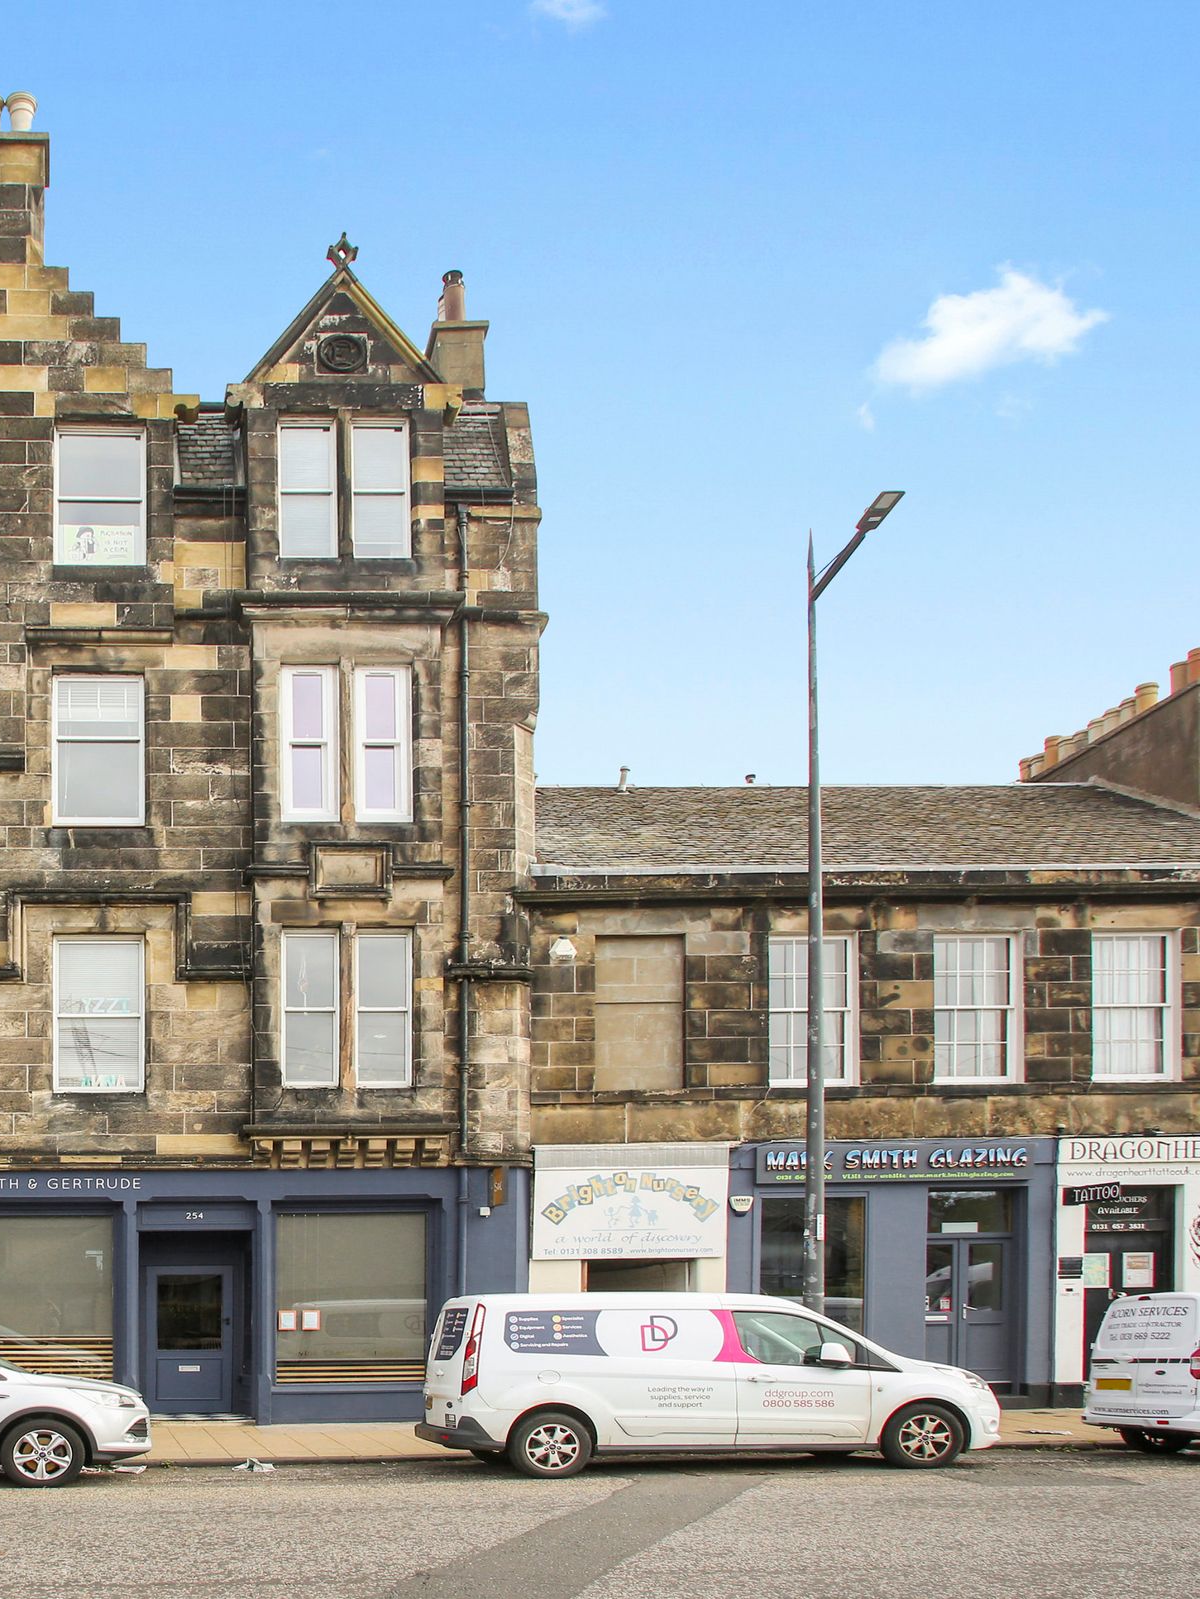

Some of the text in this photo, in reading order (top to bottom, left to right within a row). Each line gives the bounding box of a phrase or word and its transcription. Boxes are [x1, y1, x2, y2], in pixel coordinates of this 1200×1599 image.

[845, 1149, 918, 1169] SMITH
[929, 1147, 1028, 1168] GLAZING
[27, 1178, 38, 1190] &
[47, 1178, 142, 1190] GERTRUDE
[542, 1171, 720, 1225] Brighton Nursery
[1073, 1184, 1120, 1202] TATTOO
[186, 1212, 204, 1220] 254
[574, 1232, 612, 1243] world
[621, 1232, 638, 1244] of
[641, 1232, 702, 1244] discovery
[1110, 1306, 1189, 1319] ACORN SERVICES
[1134, 1332, 1148, 1340] 669
[1150, 1332, 1171, 1340] 5222
[764, 1389, 834, 1399] ddgroup.com
[762, 1400, 835, 1408] 0800 585 586
[1094, 1406, 1169, 1415] www.acornservices.com
